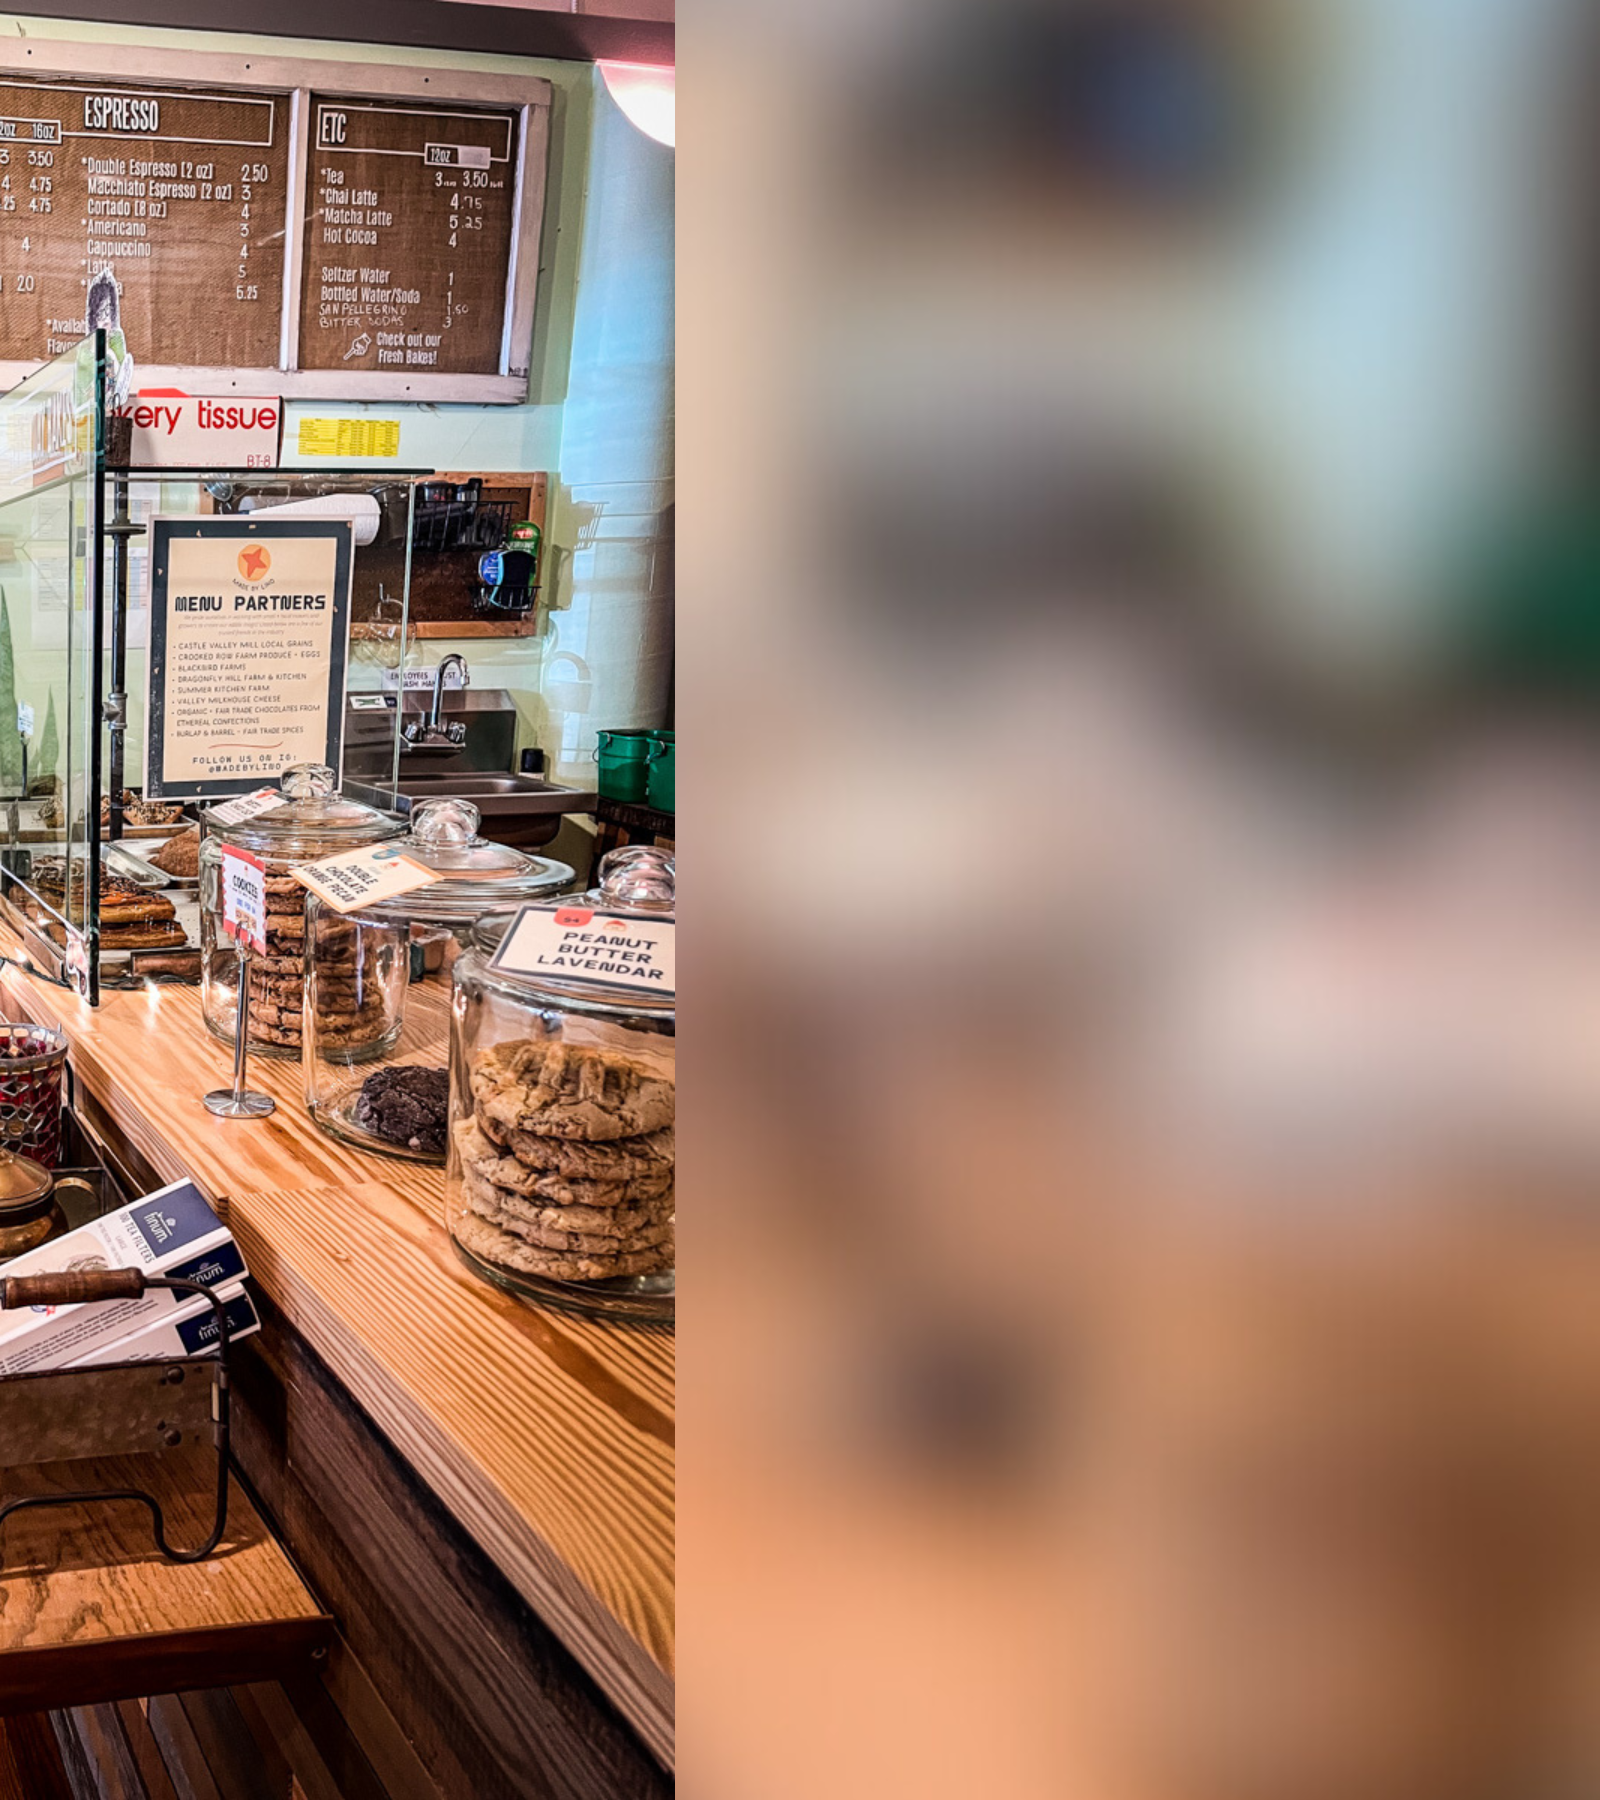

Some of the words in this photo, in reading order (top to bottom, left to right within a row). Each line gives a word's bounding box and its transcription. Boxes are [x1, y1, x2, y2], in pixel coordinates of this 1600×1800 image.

[84, 95, 159, 131] ESPRESSO
[32, 122, 55, 139] 16oz
[321, 112, 347, 143] ETC
[27, 150, 53, 167] 3.50
[430, 147, 451, 163] 12oz
[129, 158, 177, 178] Espresso
[241, 164, 268, 183] 2.50
[435, 171, 443, 187] 3
[462, 170, 488, 188] 3.50
[1, 174, 10, 191] 4
[29, 177, 52, 193] 4.75
[88, 178, 145, 198] Macchiato
[149, 180, 197, 199] Espresso
[241, 185, 251, 201] 3
[29, 197, 52, 213] 4.75
[352, 188, 378, 206] Latte
[450, 193, 483, 210] 4.75
[88, 198, 131, 217] Cortado
[241, 203, 250, 220] 4
[366, 209, 393, 226] Latte
[449, 215, 482, 230] 5.25
[240, 223, 250, 238] 3
[323, 227, 342, 244] Hot
[345, 228, 377, 245] Cocoa
[448, 232, 457, 248] 4
[21, 236, 31, 252] 4
[87, 239, 151, 258] Cappuccino
[239, 244, 248, 259] 4
[237, 264, 247, 279] 5
[321, 266, 357, 283] Seltzer
[359, 267, 390, 284] Water
[448, 272, 454, 286] 1
[16, 274, 34, 292] 20
[321, 285, 357, 302] Bottled
[361, 287, 420, 304] Water/Soda
[447, 291, 452, 305] 1
[319, 303, 339, 316] SAN
[342, 303, 407, 316] PELLEGRINO
[319, 316, 361, 328] BITTER
[368, 316, 404, 327] SODAS
[442, 316, 452, 328] 3
[376, 331, 405, 346] Check
[407, 332, 423, 347] out
[426, 334, 442, 347] our
[378, 349, 403, 364] Fresh
[406, 350, 437, 365] Bakes!
[198, 400, 277, 429] tissue
[247, 454, 271, 468] BT-8
[175, 596, 222, 612] MENU
[234, 594, 326, 611] PARTNERS
[178, 642, 206, 650] CASTLE
[209, 641, 237, 650] VALLEY
[240, 641, 259, 649] MILL
[261, 641, 284, 649] LOCAL
[287, 640, 313, 648] GRAINS
[178, 653, 214, 661] CROOKED
[216, 652, 233, 660] ROW
[235, 651, 257, 660] FARM
[259, 651, 292, 659] PRODUCE
[301, 650, 321, 659] EGGS
[178, 664, 218, 672] BLACKBIRD
[220, 663, 246, 671] FARMS
[178, 675, 222, 683] DRAGONFLY
[225, 674, 242, 682] HILL
[276, 673, 307, 681] KITCHEN
[177, 686, 212, 694] SUMMER
[214, 685, 246, 693] KITCHEN
[249, 684, 270, 692] FARM
[177, 697, 205, 705] VALLEY
[208, 696, 252, 704] MILKHOUSE
[253, 695, 281, 703] CHEESE
[176, 707, 208, 716] ORGANIC
[232, 706, 253, 714] TRADE
[254, 705, 298, 713] CHOCOLATES
[300, 704, 321, 712] FROM
[176, 719, 210, 727] ETHEREAL
[212, 717, 260, 726] CONFECTIONS
[176, 730, 202, 738] BURLAP
[211, 728, 235, 736] BARREL
[243, 727, 258, 735] FAIR
[260, 726, 280, 735] TRADE
[281, 726, 304, 734] SPICES
[192, 756, 232, 764] FOLLOW
[239, 755, 252, 763] US
[259, 754, 272, 762] ON
[279, 753, 297, 761] IG:
[325, 866, 368, 894] CHOCOLATE
[346, 865, 378, 884] DOUBLE
[563, 932, 658, 950] PEANUT
[558, 944, 652, 964] BUTTER
[537, 954, 664, 980] LAVENDAR
[126, 1222, 136, 1236] TEA
[134, 1233, 156, 1264] FILTERS
